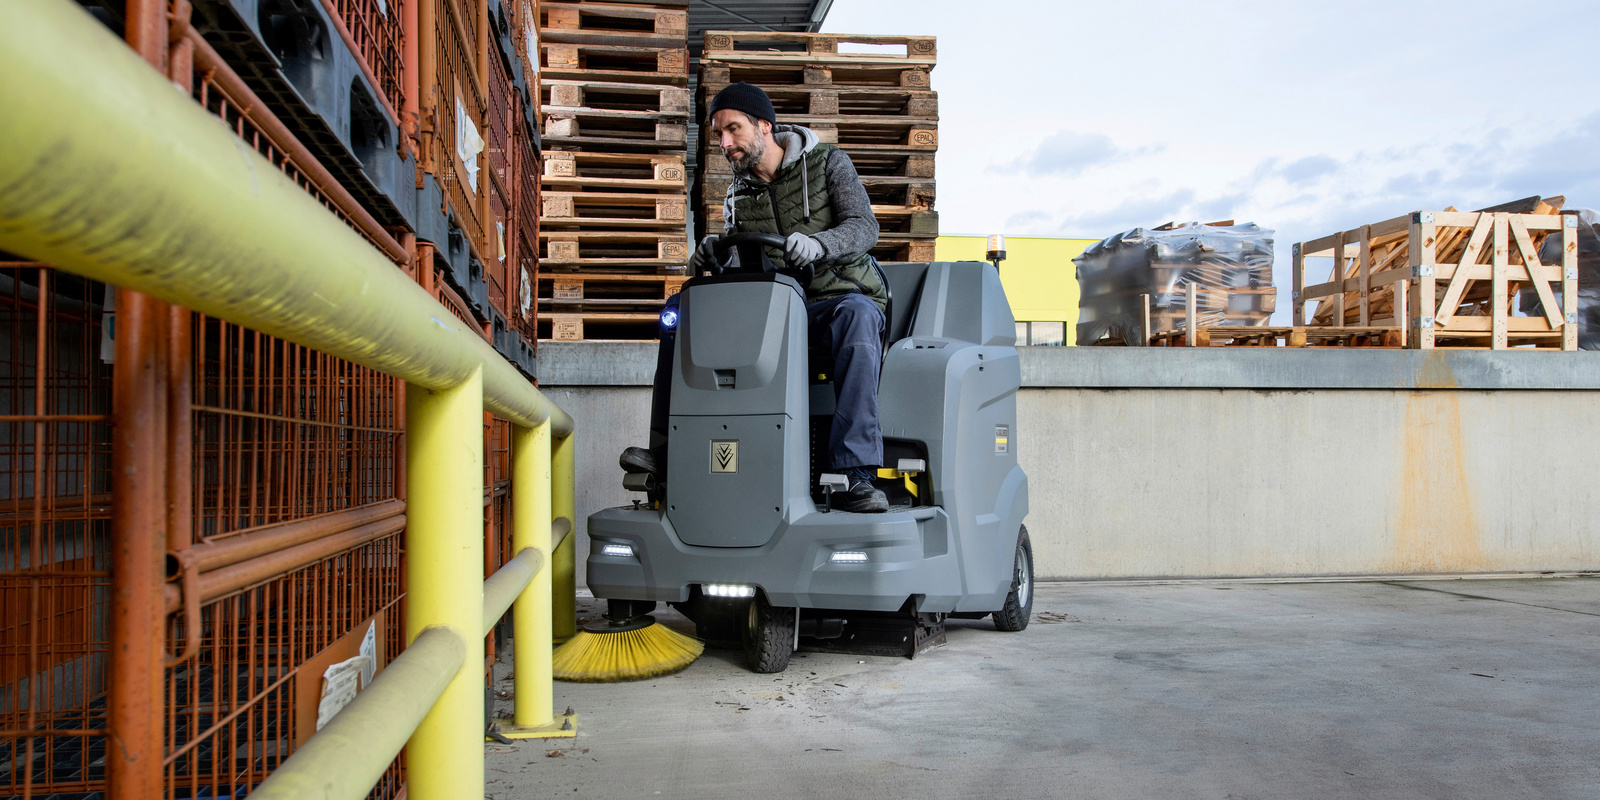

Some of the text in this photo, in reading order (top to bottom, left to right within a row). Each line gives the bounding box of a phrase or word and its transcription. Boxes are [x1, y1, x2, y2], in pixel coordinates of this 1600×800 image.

[917, 134, 931, 142] EPAL
[665, 170, 678, 178] EUR
[665, 207, 678, 216] EUR
